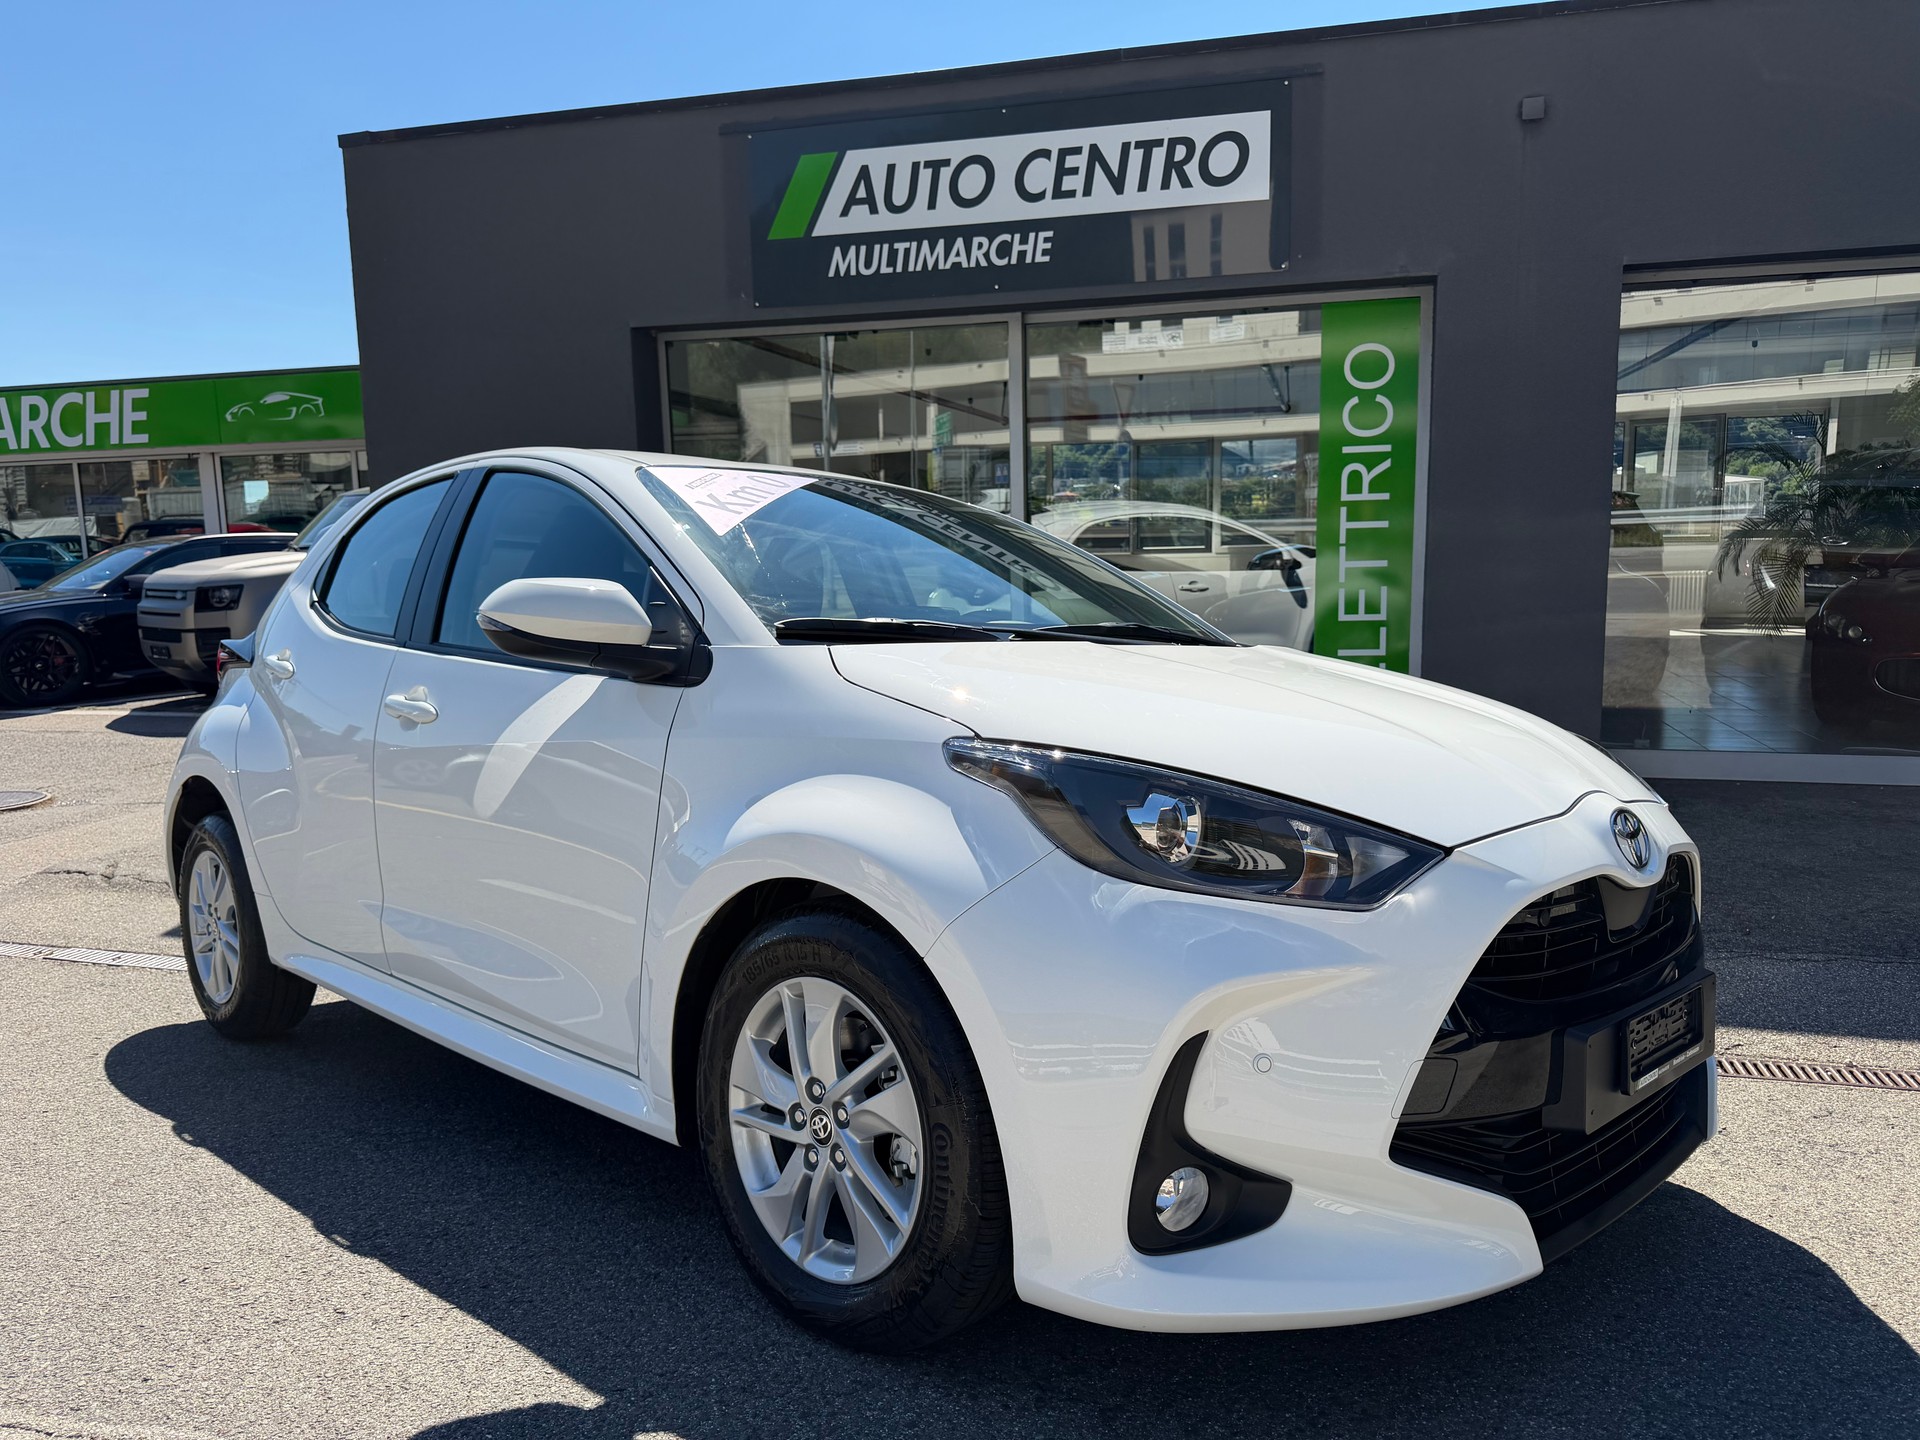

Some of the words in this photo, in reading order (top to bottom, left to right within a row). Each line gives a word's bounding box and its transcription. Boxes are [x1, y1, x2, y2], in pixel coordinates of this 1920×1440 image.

[839, 154, 995, 218] AUTO
[1014, 130, 1250, 203] CENTRO
[828, 231, 1054, 277] MULTIMARCHE
[694, 485, 776, 515] Km
[746, 475, 791, 488] 0
[1337, 342, 1395, 669] LETTRICO
